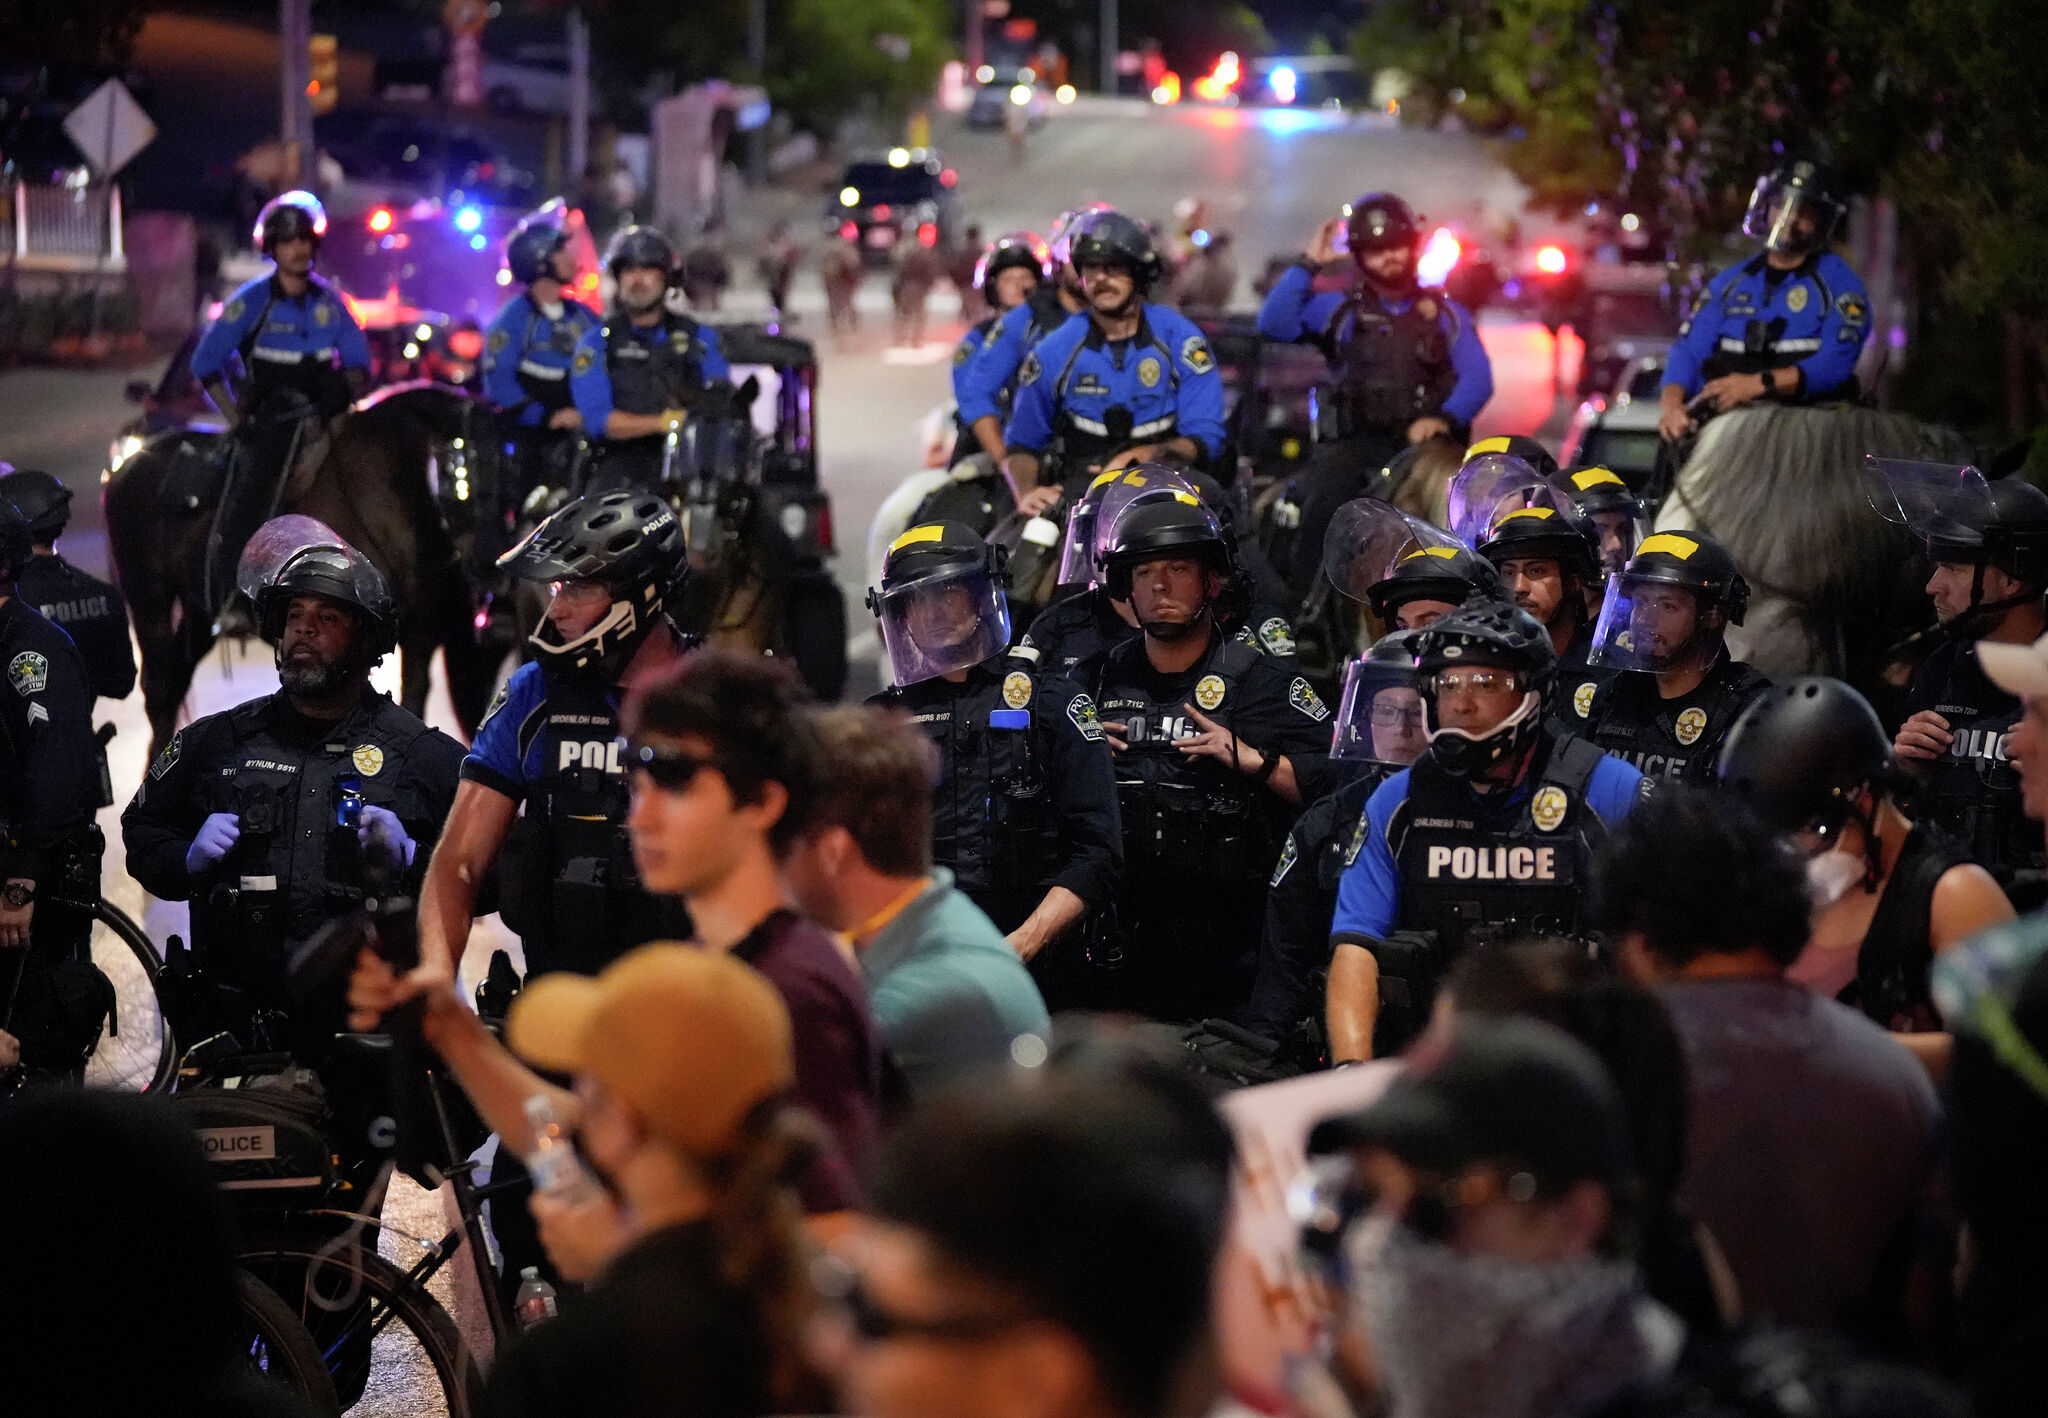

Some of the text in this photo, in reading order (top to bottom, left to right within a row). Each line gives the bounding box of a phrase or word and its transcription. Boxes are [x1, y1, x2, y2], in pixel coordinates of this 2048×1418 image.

[642, 512, 673, 536] POLICE
[11, 653, 45, 676] POLICE
[1104, 700, 1145, 709] VEGA 7112
[936, 712, 951, 720] 8107
[245, 760, 276, 769] BYNUM
[558, 741, 628, 775] POL
[1427, 845, 1556, 880] POLICE
[199, 1135, 263, 1153] OLICE
